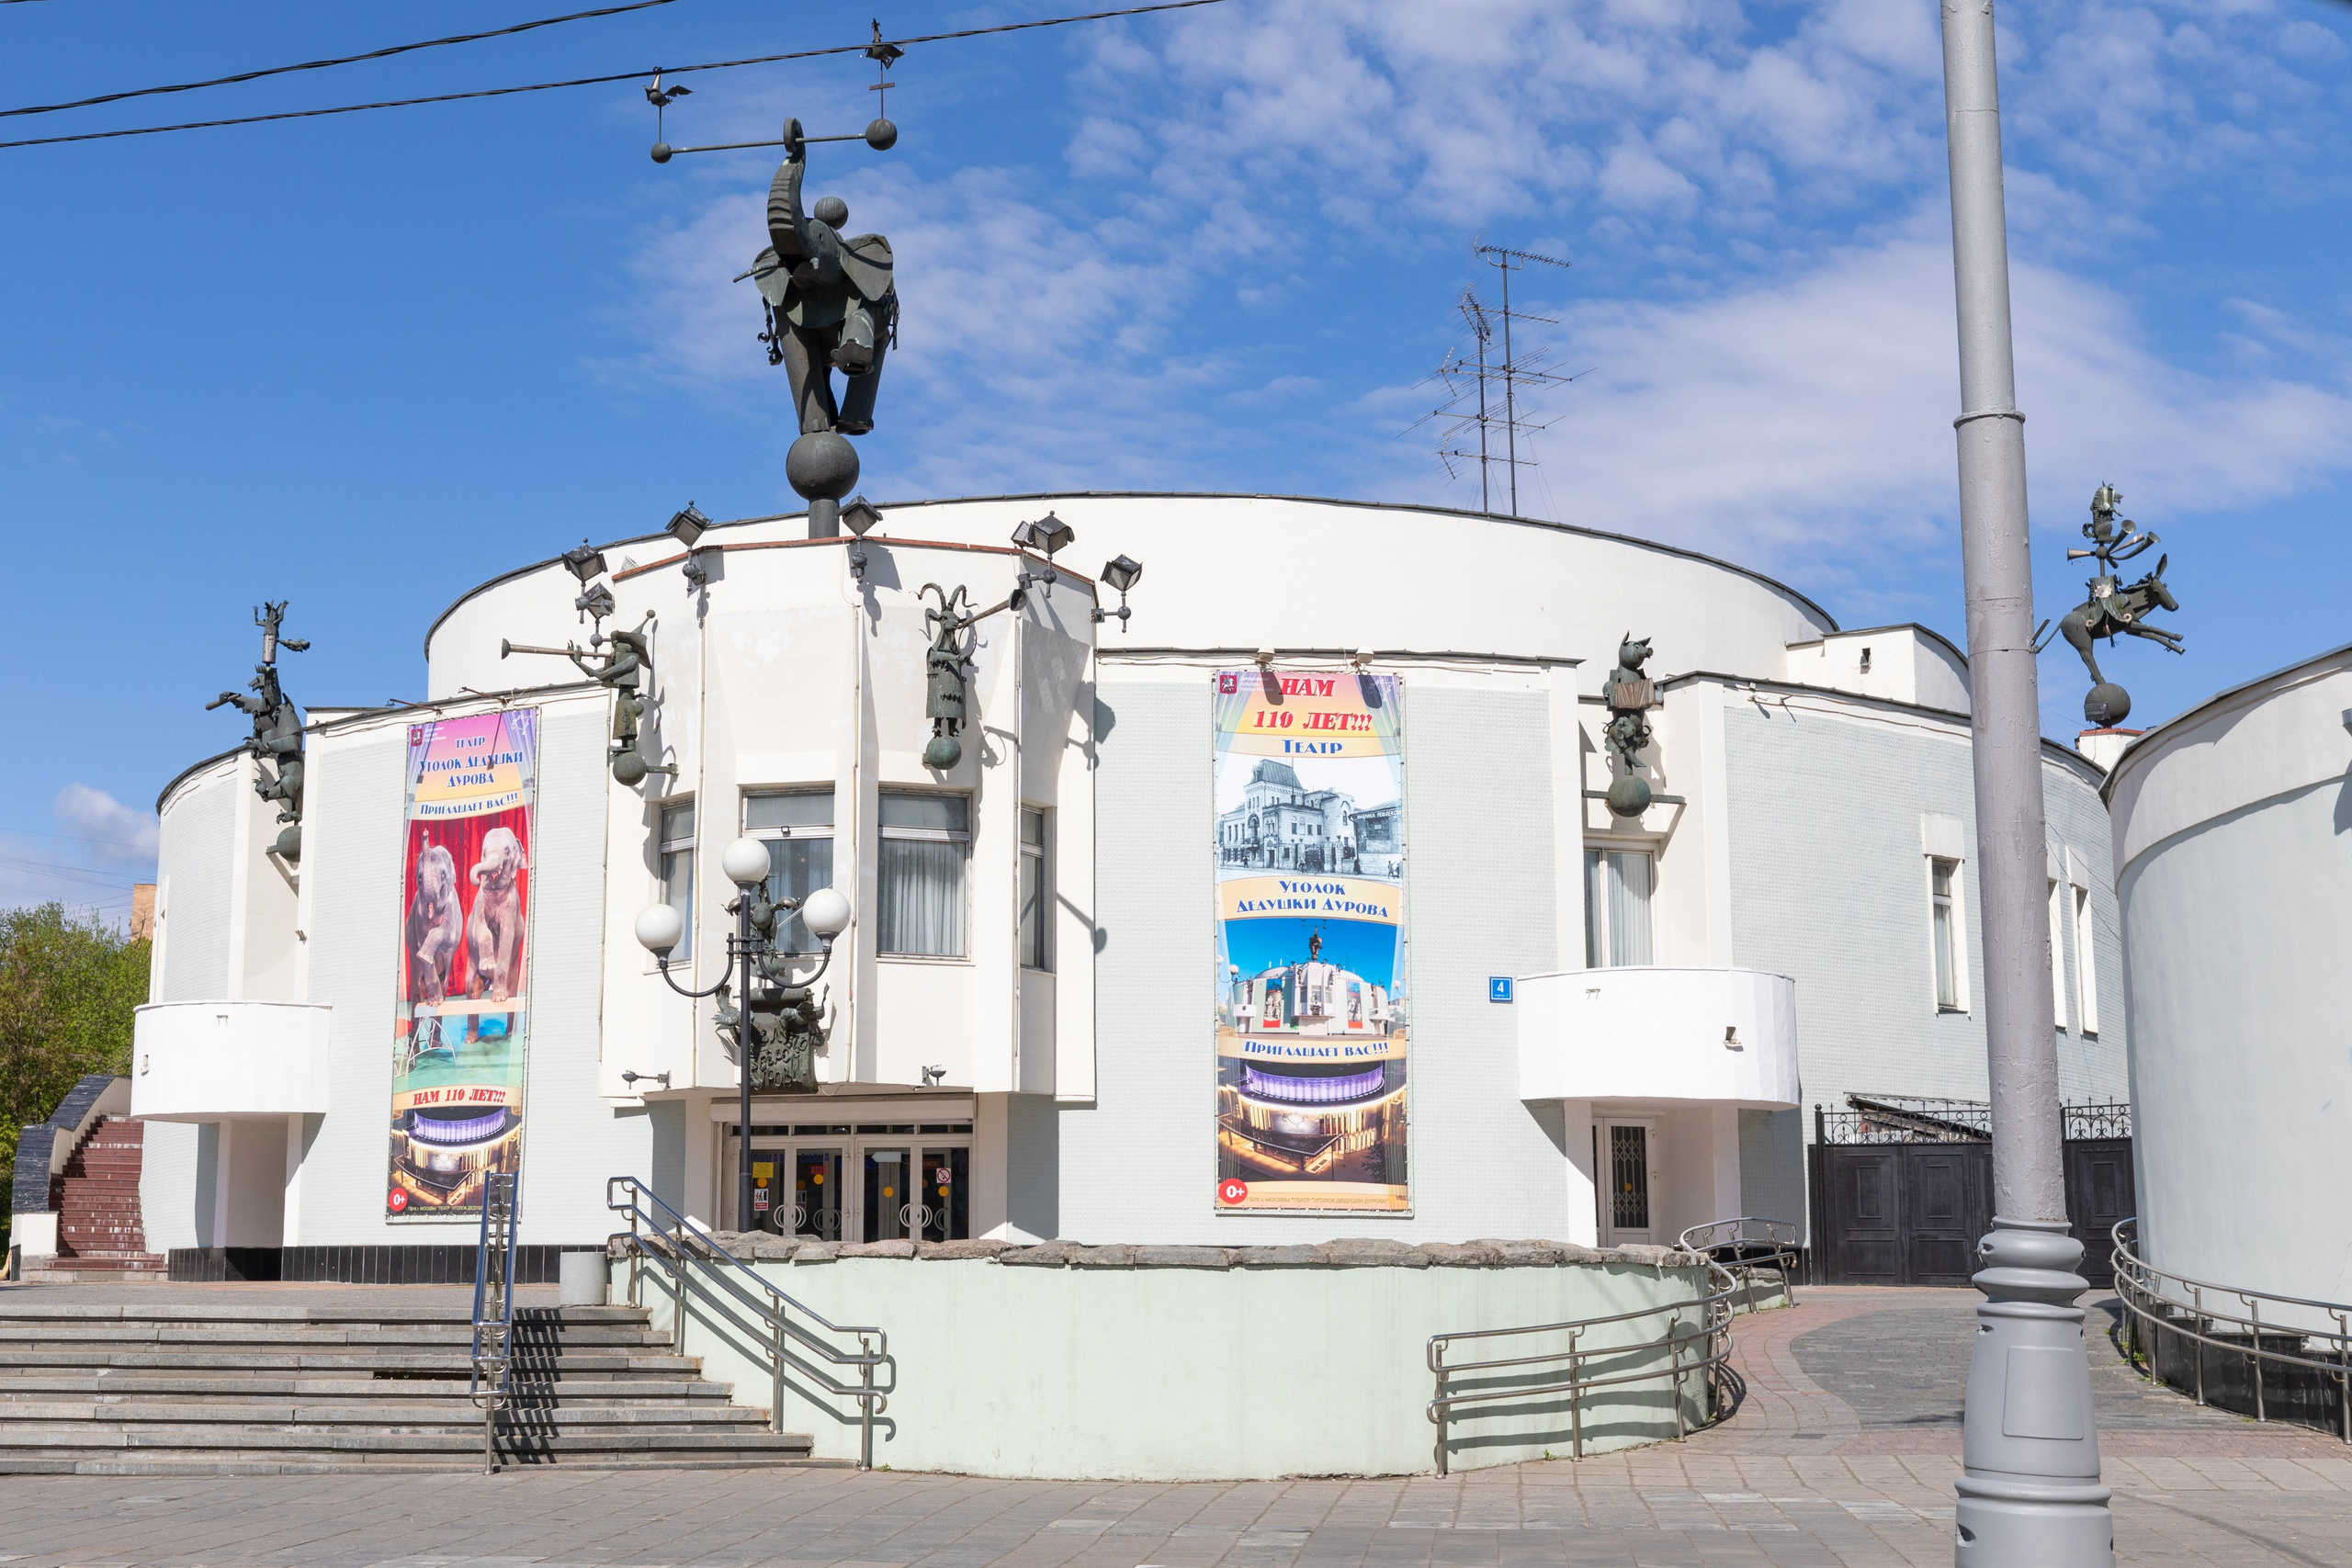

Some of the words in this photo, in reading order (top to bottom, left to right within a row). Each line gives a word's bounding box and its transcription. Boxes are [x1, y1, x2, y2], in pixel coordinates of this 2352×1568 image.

[1279, 678, 1335, 697] НАМ
[1253, 711, 1294, 728] 110
[1303, 712, 1373, 731] ЛЕТ!!!
[455, 737, 485, 749] ТЕАТР
[1281, 739, 1342, 754] ТЕАТР
[419, 758, 461, 773] УГОЛОК
[465, 750, 524, 769] ДЕДУШКИ
[447, 773, 494, 788] ДУРОВА
[420, 802, 483, 816] ПРИГЛАШАЕТ
[486, 793, 518, 809] ВАС!!!
[1279, 880, 1346, 896] УГОЛОК
[1237, 898, 1317, 913] ДЕДУШКИ
[1321, 898, 1388, 918] ДУРОВА
[1497, 981, 1504, 993] 4
[1244, 1041, 1340, 1056] ПРИГЛАШАЕТ
[1344, 1042, 1389, 1056] ВАС!!!
[413, 1089, 440, 1106] НАМ
[445, 1089, 466, 1101] 110
[469, 1089, 506, 1103] ЛЕТ!!!
[1226, 1185, 1245, 1198] 0+
[393, 1194, 405, 1206] 0+
